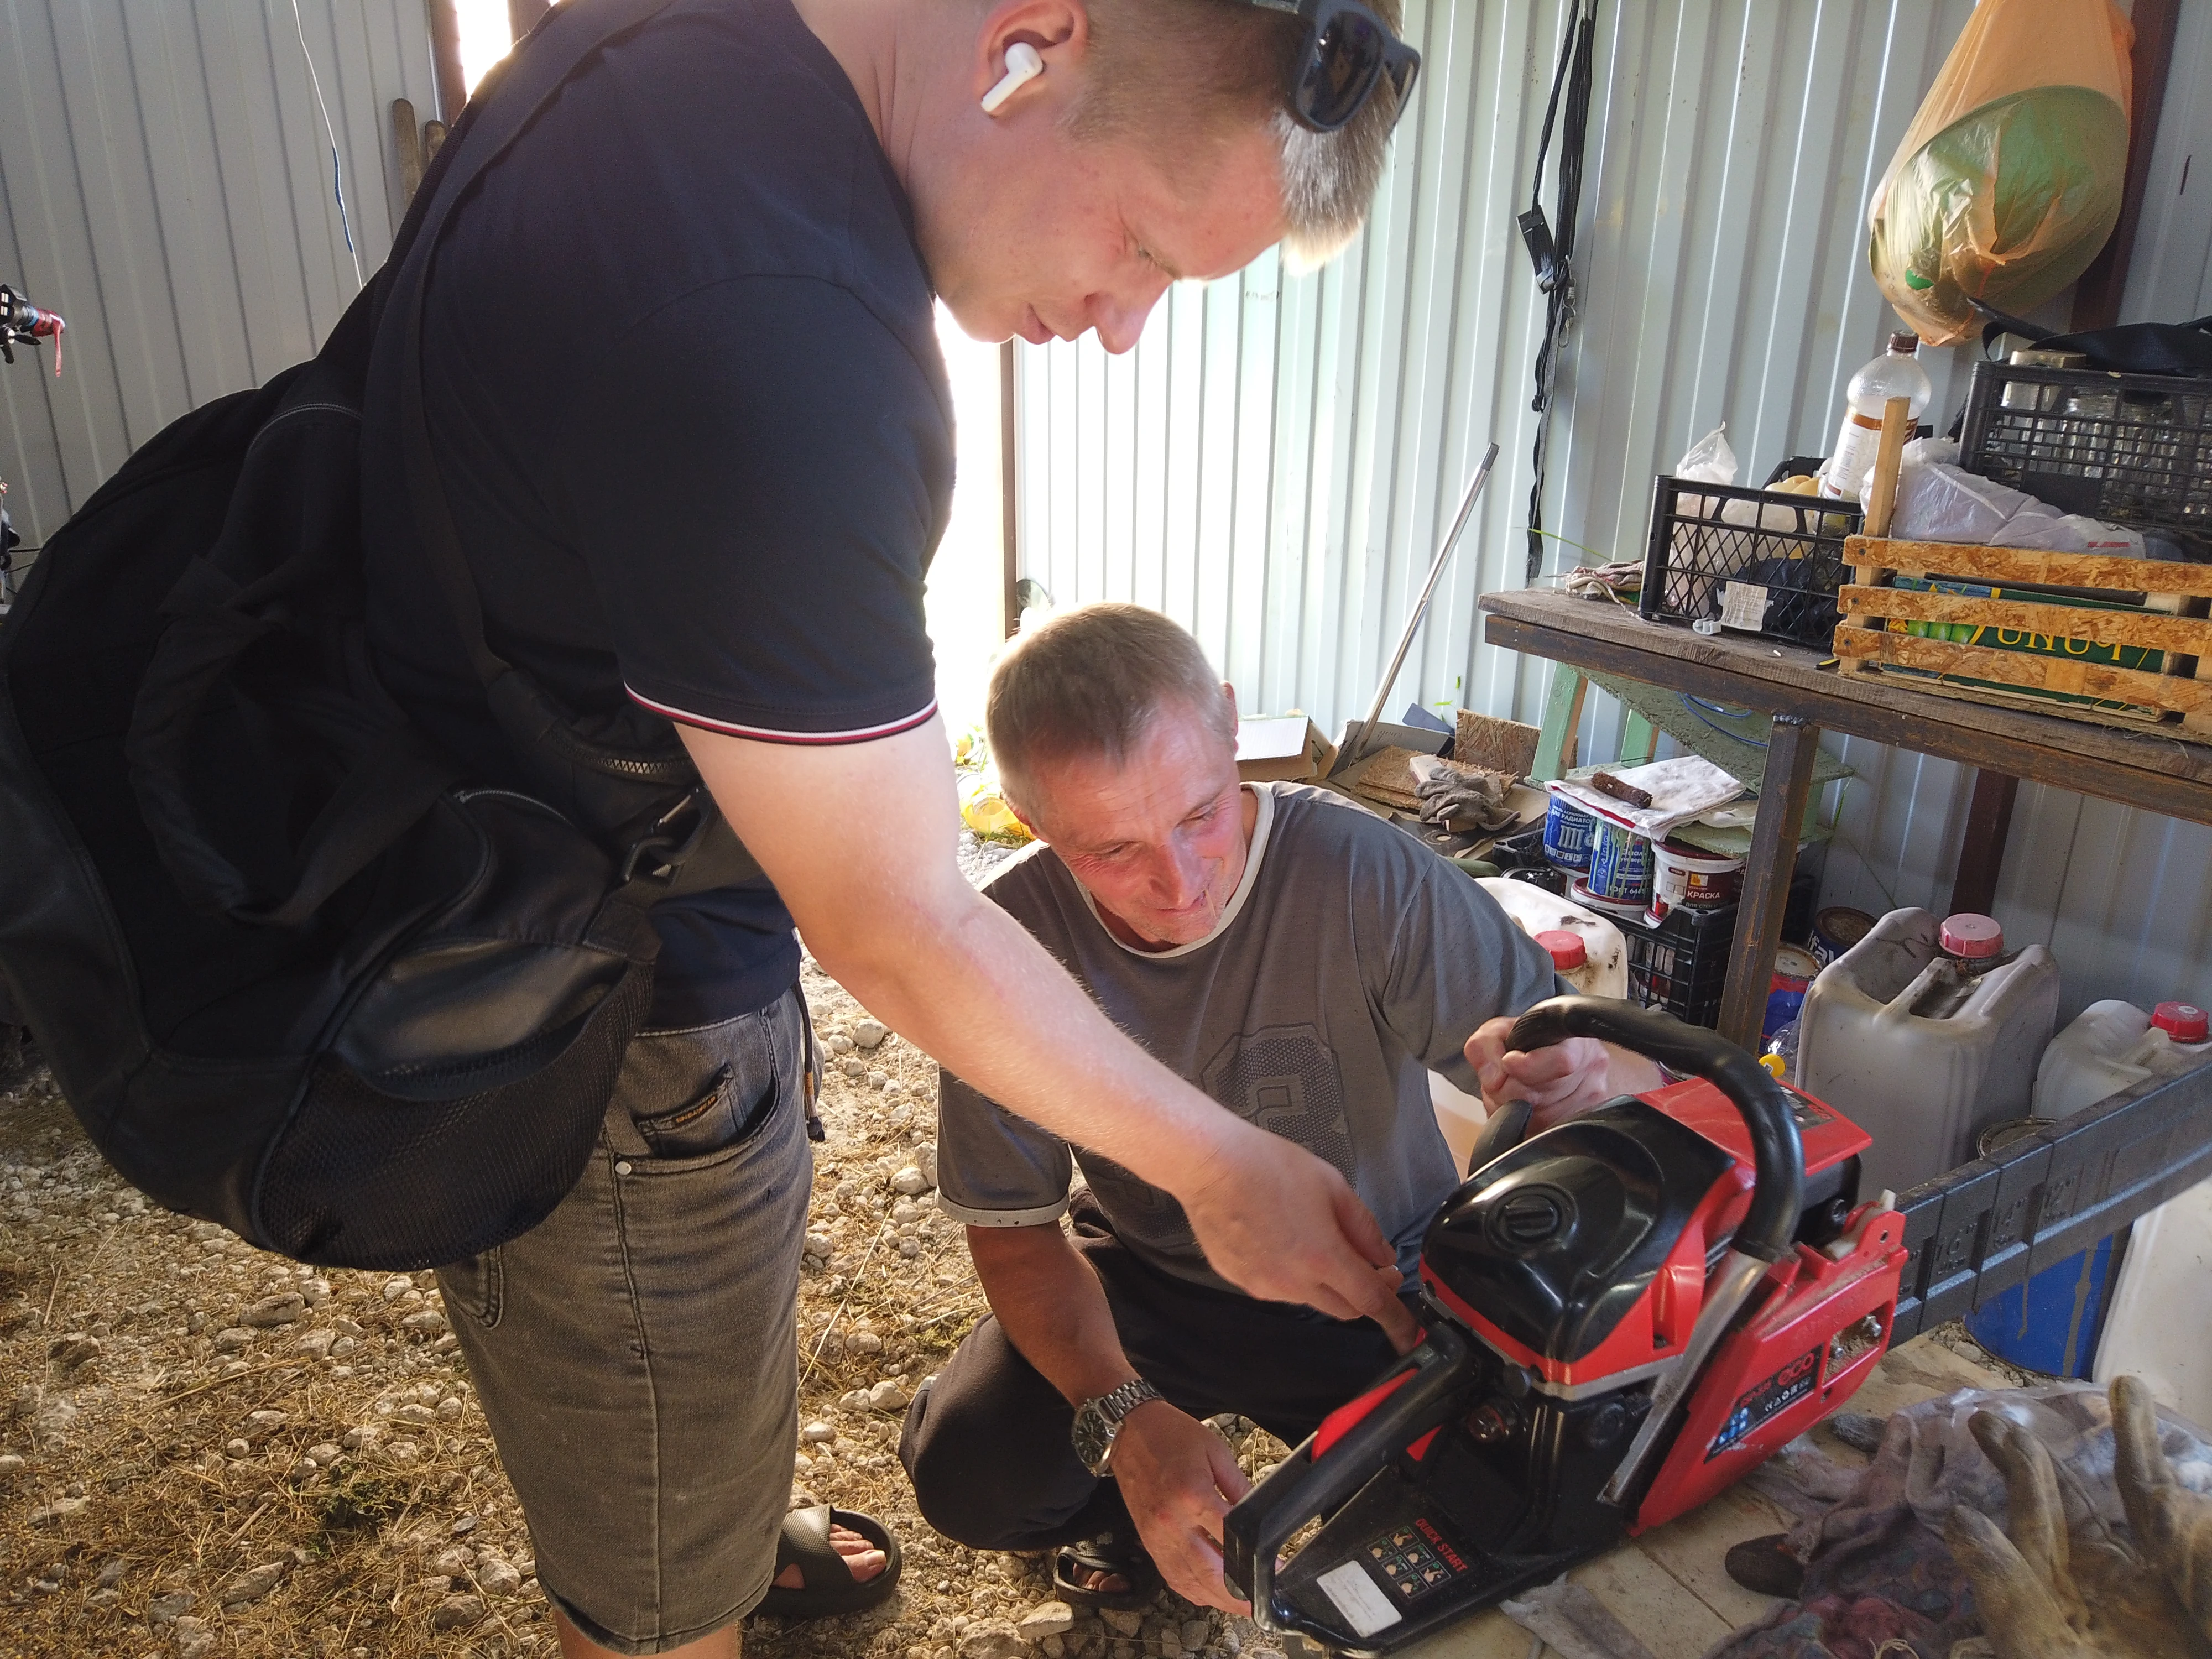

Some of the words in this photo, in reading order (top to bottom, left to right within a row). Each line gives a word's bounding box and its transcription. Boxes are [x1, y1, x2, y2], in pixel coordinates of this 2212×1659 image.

[1551, 809, 1561, 817] ДЛЯ
[1687, 890, 1720, 899] КРАСКА
[1415, 1518, 1442, 1545] QUICK
[1438, 1542, 1468, 1572] START
